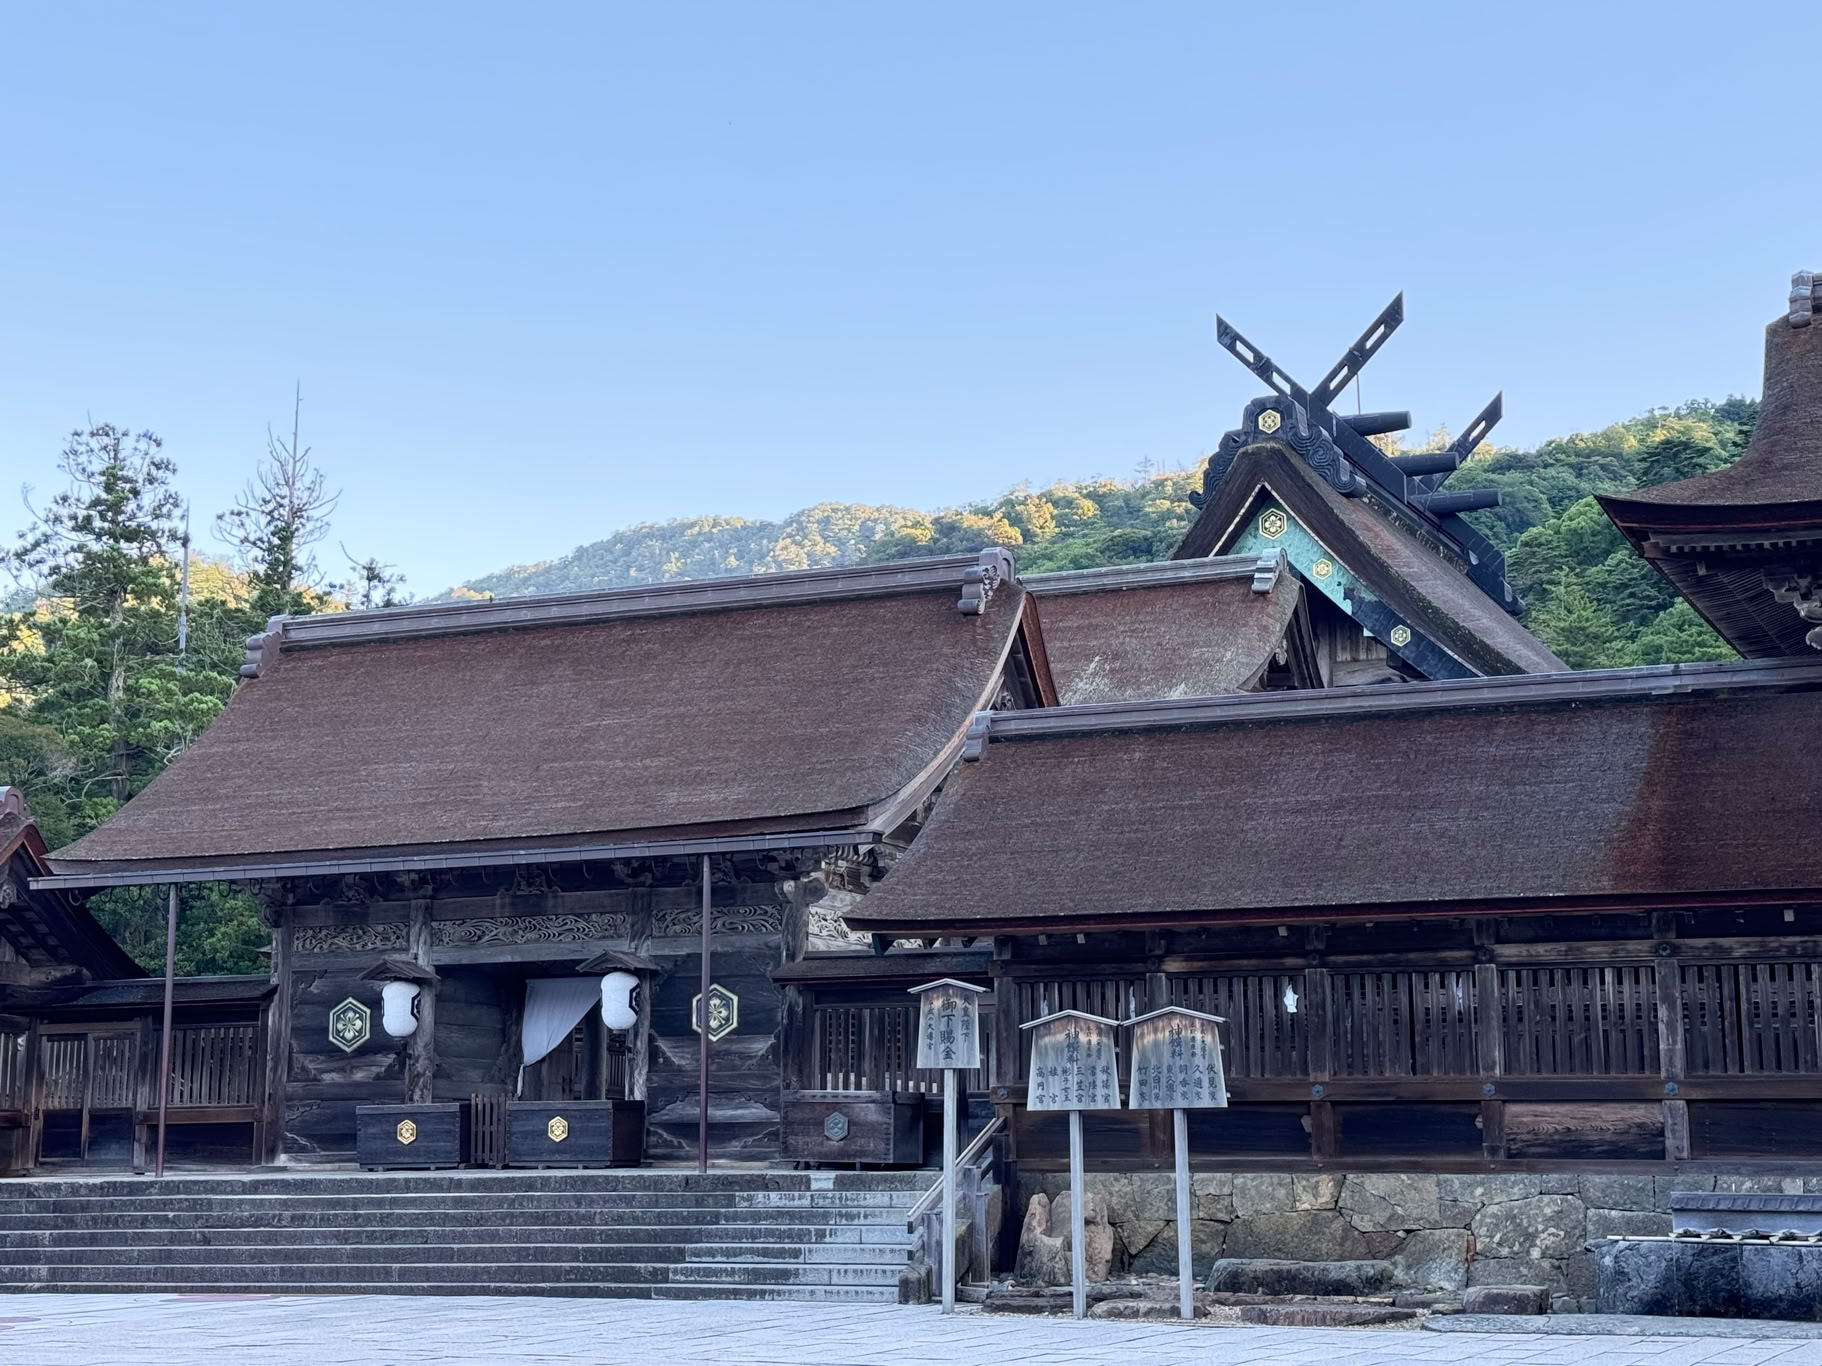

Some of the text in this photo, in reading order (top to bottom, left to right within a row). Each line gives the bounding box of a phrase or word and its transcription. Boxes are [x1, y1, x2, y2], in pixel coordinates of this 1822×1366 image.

[940, 997, 957, 1060] 御下賜金
[1036, 1066, 1045, 1104] 高円宮
[1075, 1066, 1084, 1103] 三笠宮
[1100, 1065, 1111, 1103] 秋篠宮
[1136, 1065, 1149, 1102] 竹田家
[1151, 1064, 1162, 1102] 北白川家
[1179, 1064, 1189, 1101] 朝香家
[1206, 1063, 1217, 1101] 伏見家
